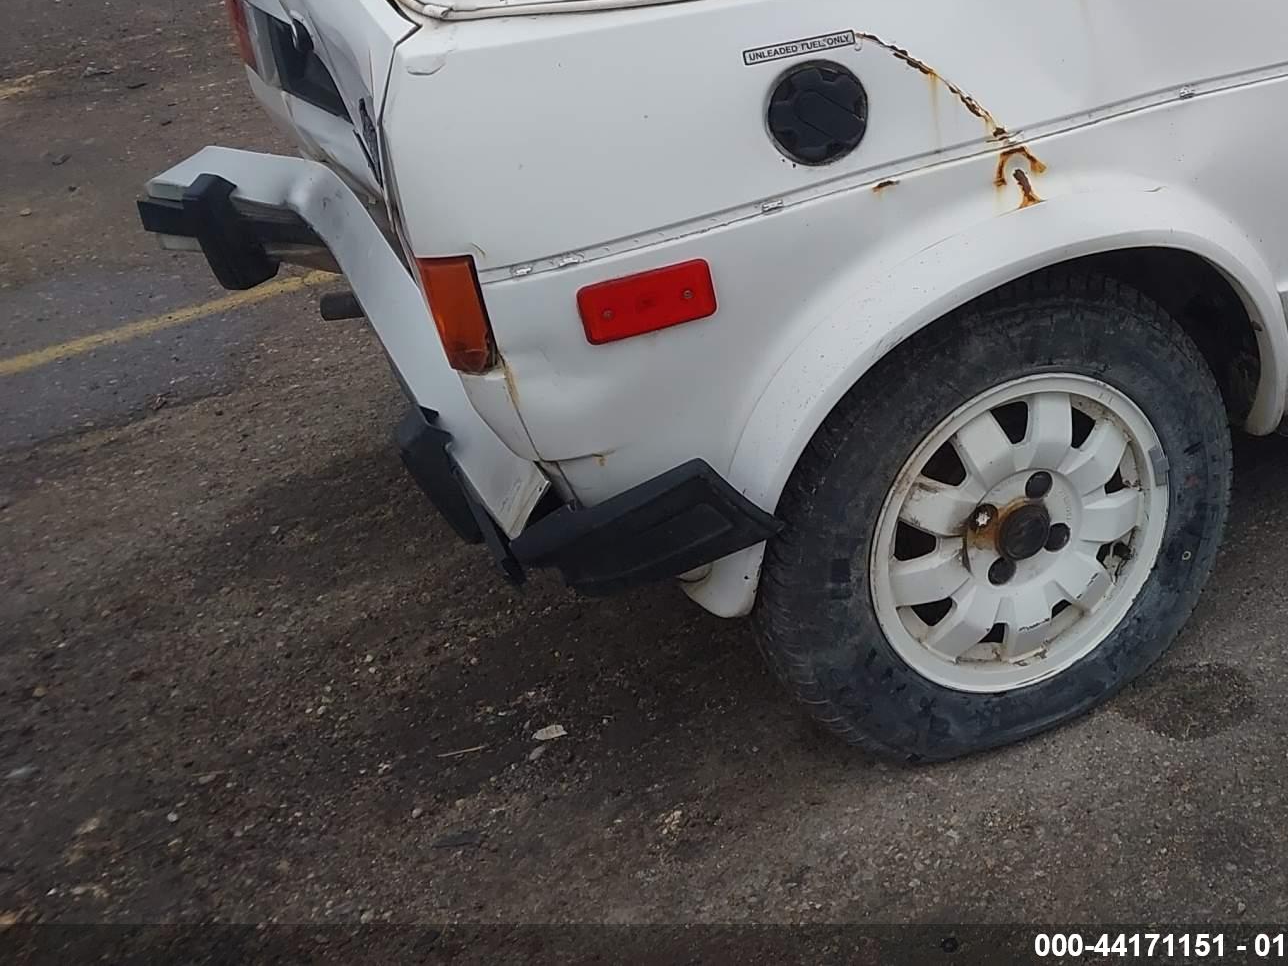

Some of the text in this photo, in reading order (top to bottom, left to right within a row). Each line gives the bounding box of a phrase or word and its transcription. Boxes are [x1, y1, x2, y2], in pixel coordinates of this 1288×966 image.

[748, 34, 850, 61] UNLEADED FUEL ONLY
